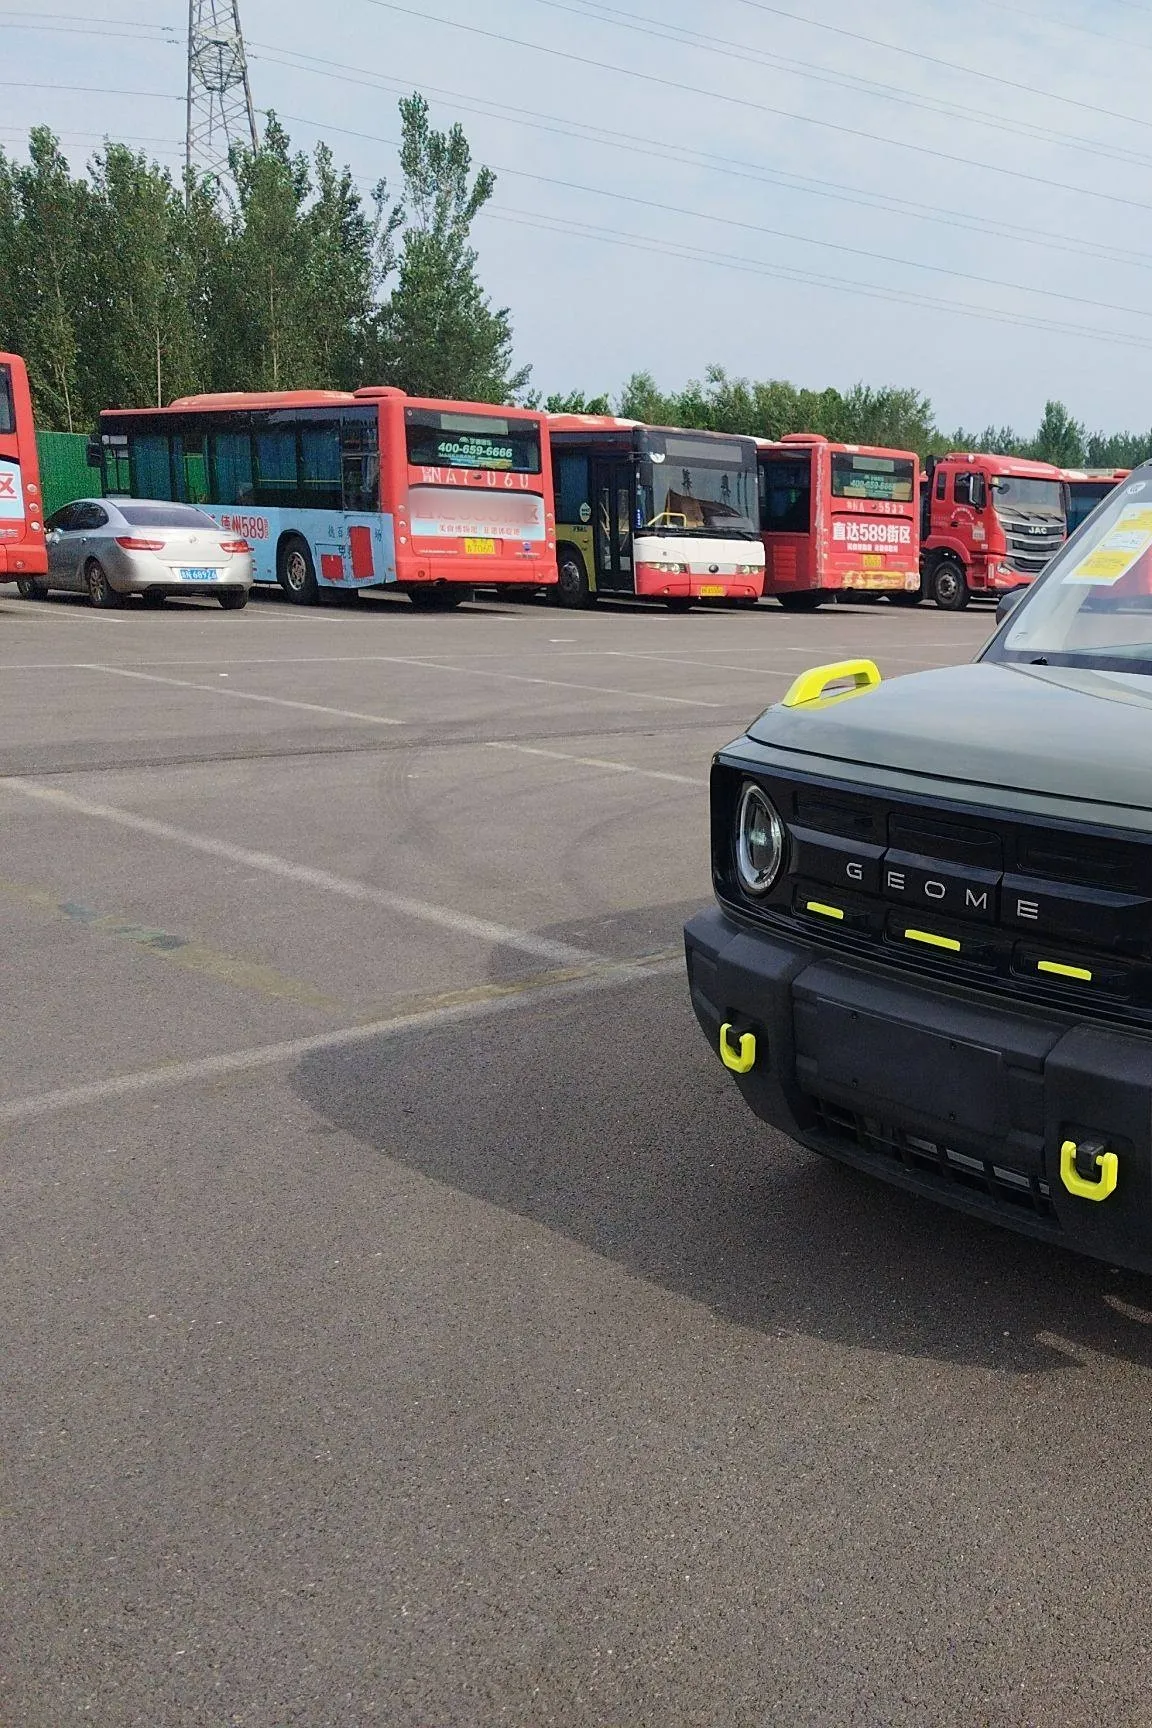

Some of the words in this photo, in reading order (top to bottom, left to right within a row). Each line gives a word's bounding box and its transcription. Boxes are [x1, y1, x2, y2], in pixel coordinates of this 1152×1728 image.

[438, 442, 513, 458] 400-659-6666
[832, 522, 911, 544] 直达589街区
[1028, 526, 1048, 535] JAC
[846, 862, 1039, 920] GEOME
